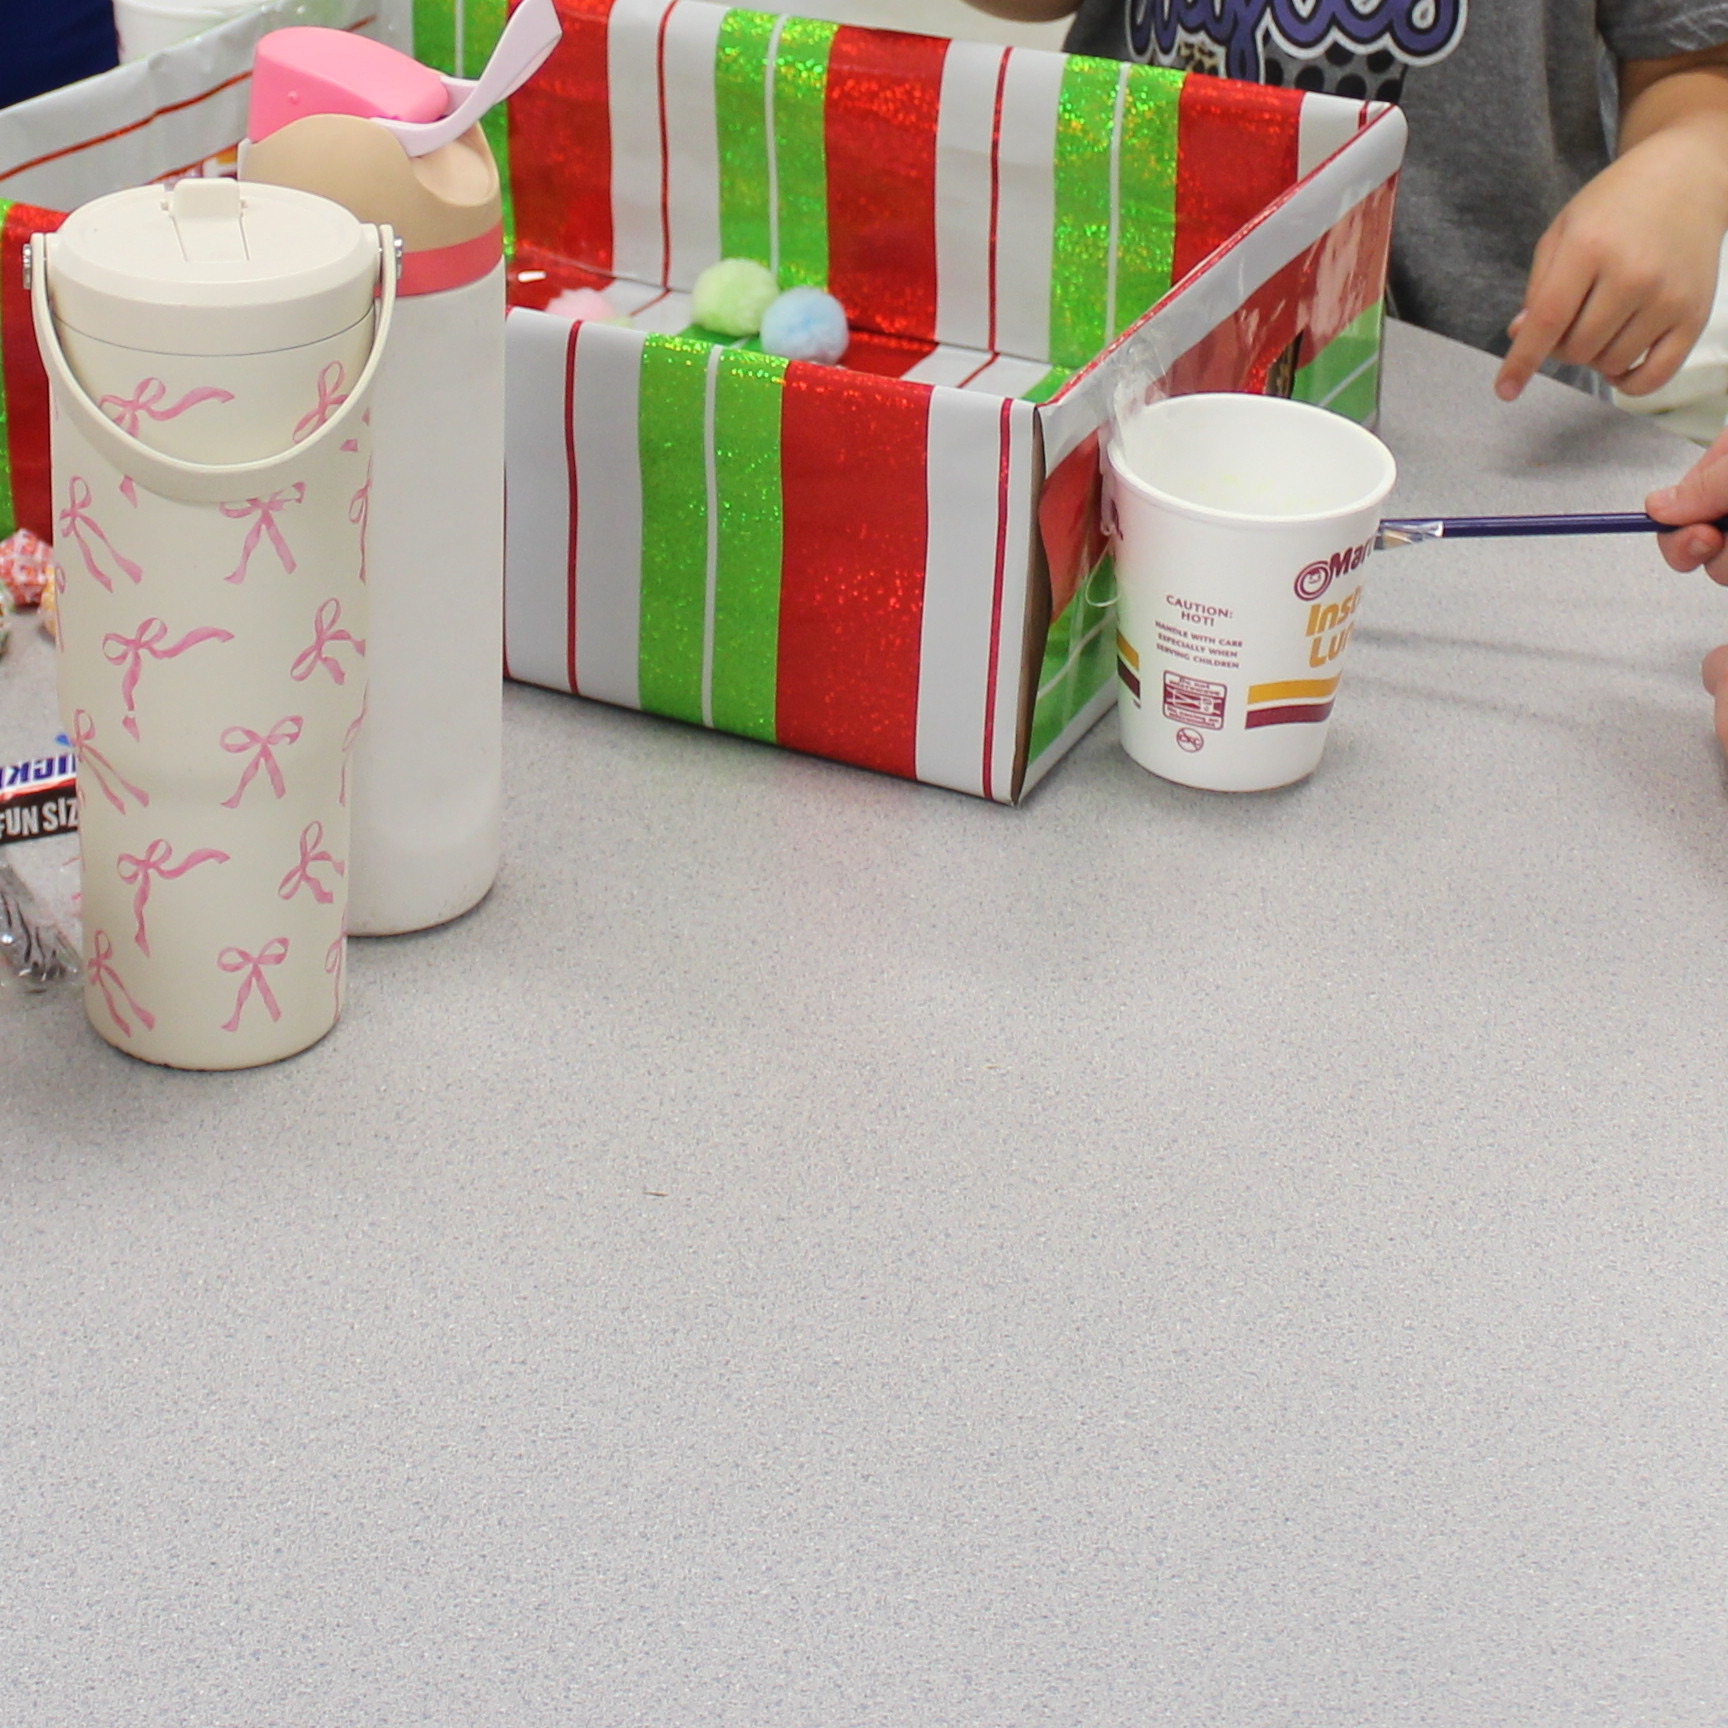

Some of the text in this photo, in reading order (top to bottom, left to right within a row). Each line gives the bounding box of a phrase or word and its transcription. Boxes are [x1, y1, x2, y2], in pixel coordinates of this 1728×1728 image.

[1166, 595, 1233, 619] CAUTION:
[1155, 620, 1243, 648] HANDLE WITH CARE
[1158, 632, 1238, 658] ESPECIALLY WHEN
[1156, 643, 1240, 669] SERVING CHILDREN
